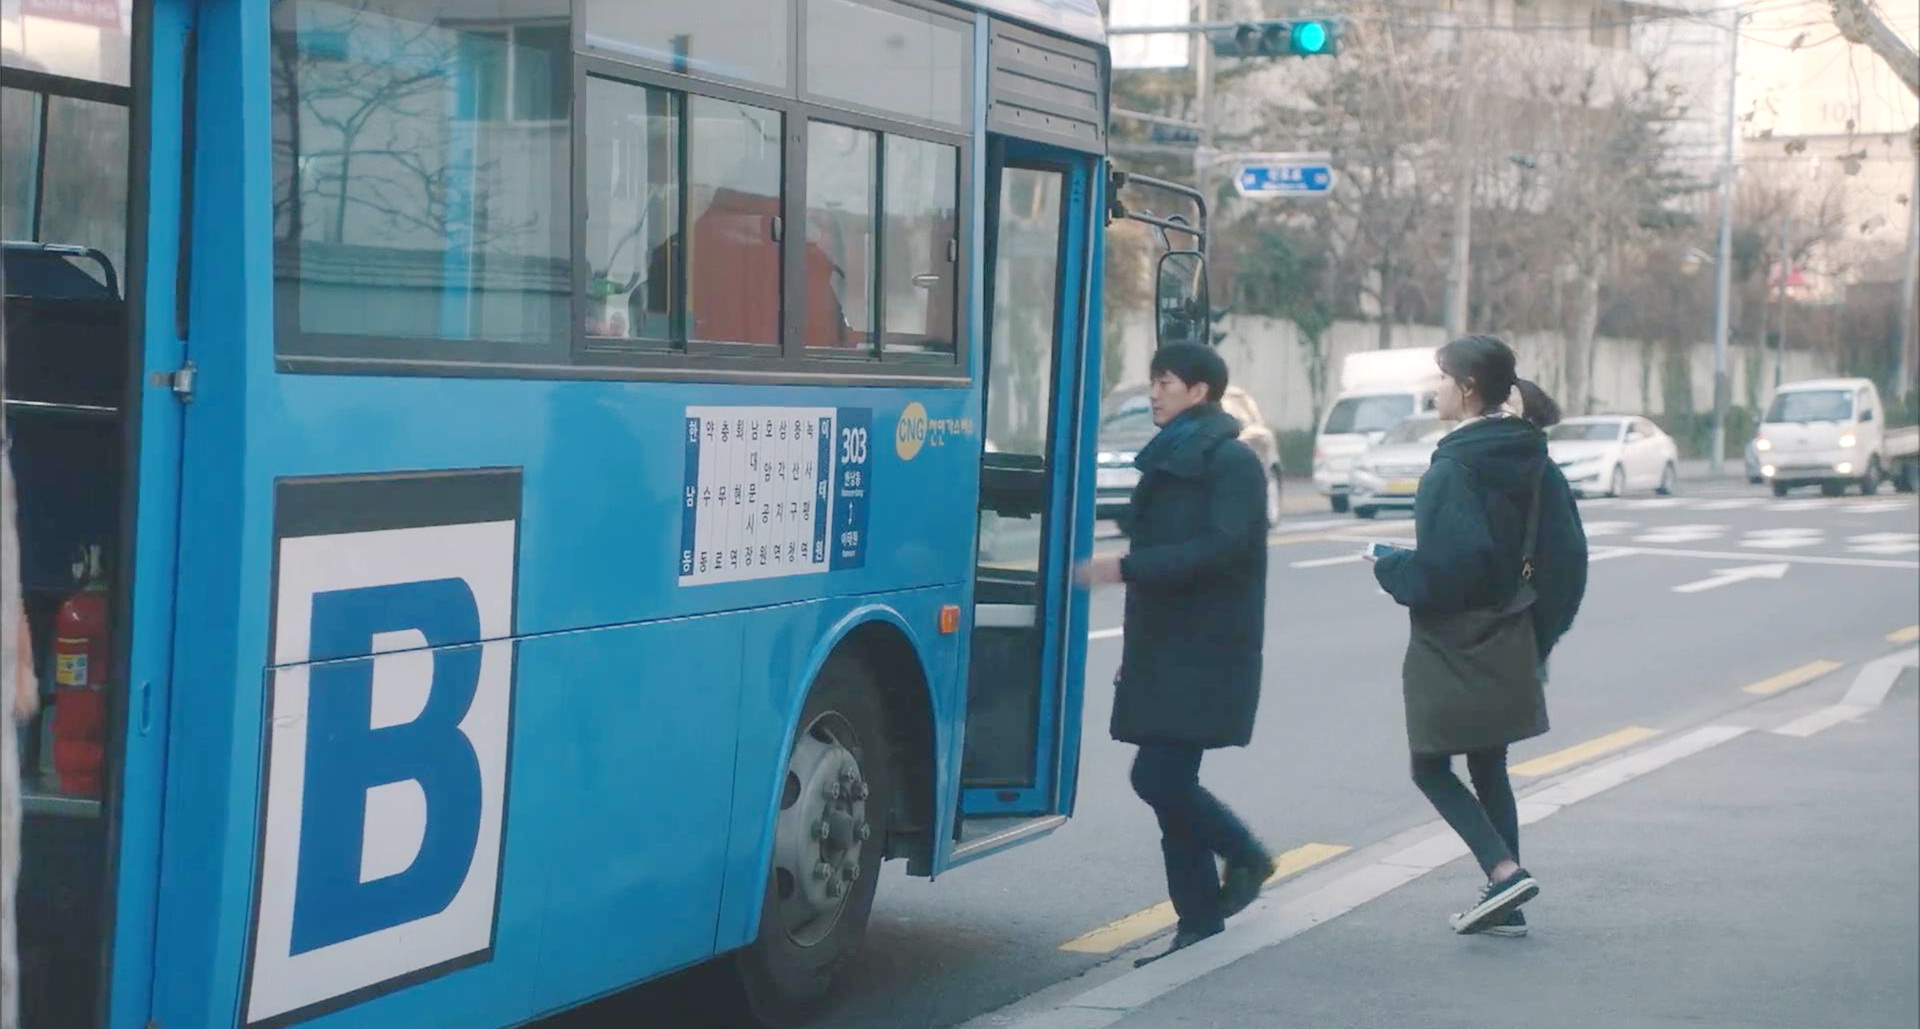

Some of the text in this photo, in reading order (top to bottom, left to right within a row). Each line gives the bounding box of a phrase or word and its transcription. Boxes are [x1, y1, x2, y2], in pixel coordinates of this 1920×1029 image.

[682, 420, 699, 572] 한남동
[700, 420, 715, 573] 약수동
[714, 420, 730, 569] 충무로
[746, 420, 759, 566] 남대문시장
[773, 420, 787, 563] 삼각지역
[787, 420, 801, 562] 용산구청
[801, 421, 814, 561] 녹사평역
[815, 420, 831, 561] 이태원
[841, 427, 867, 464] 303
[898, 418, 924, 442] CNG
[289, 576, 484, 958] B
